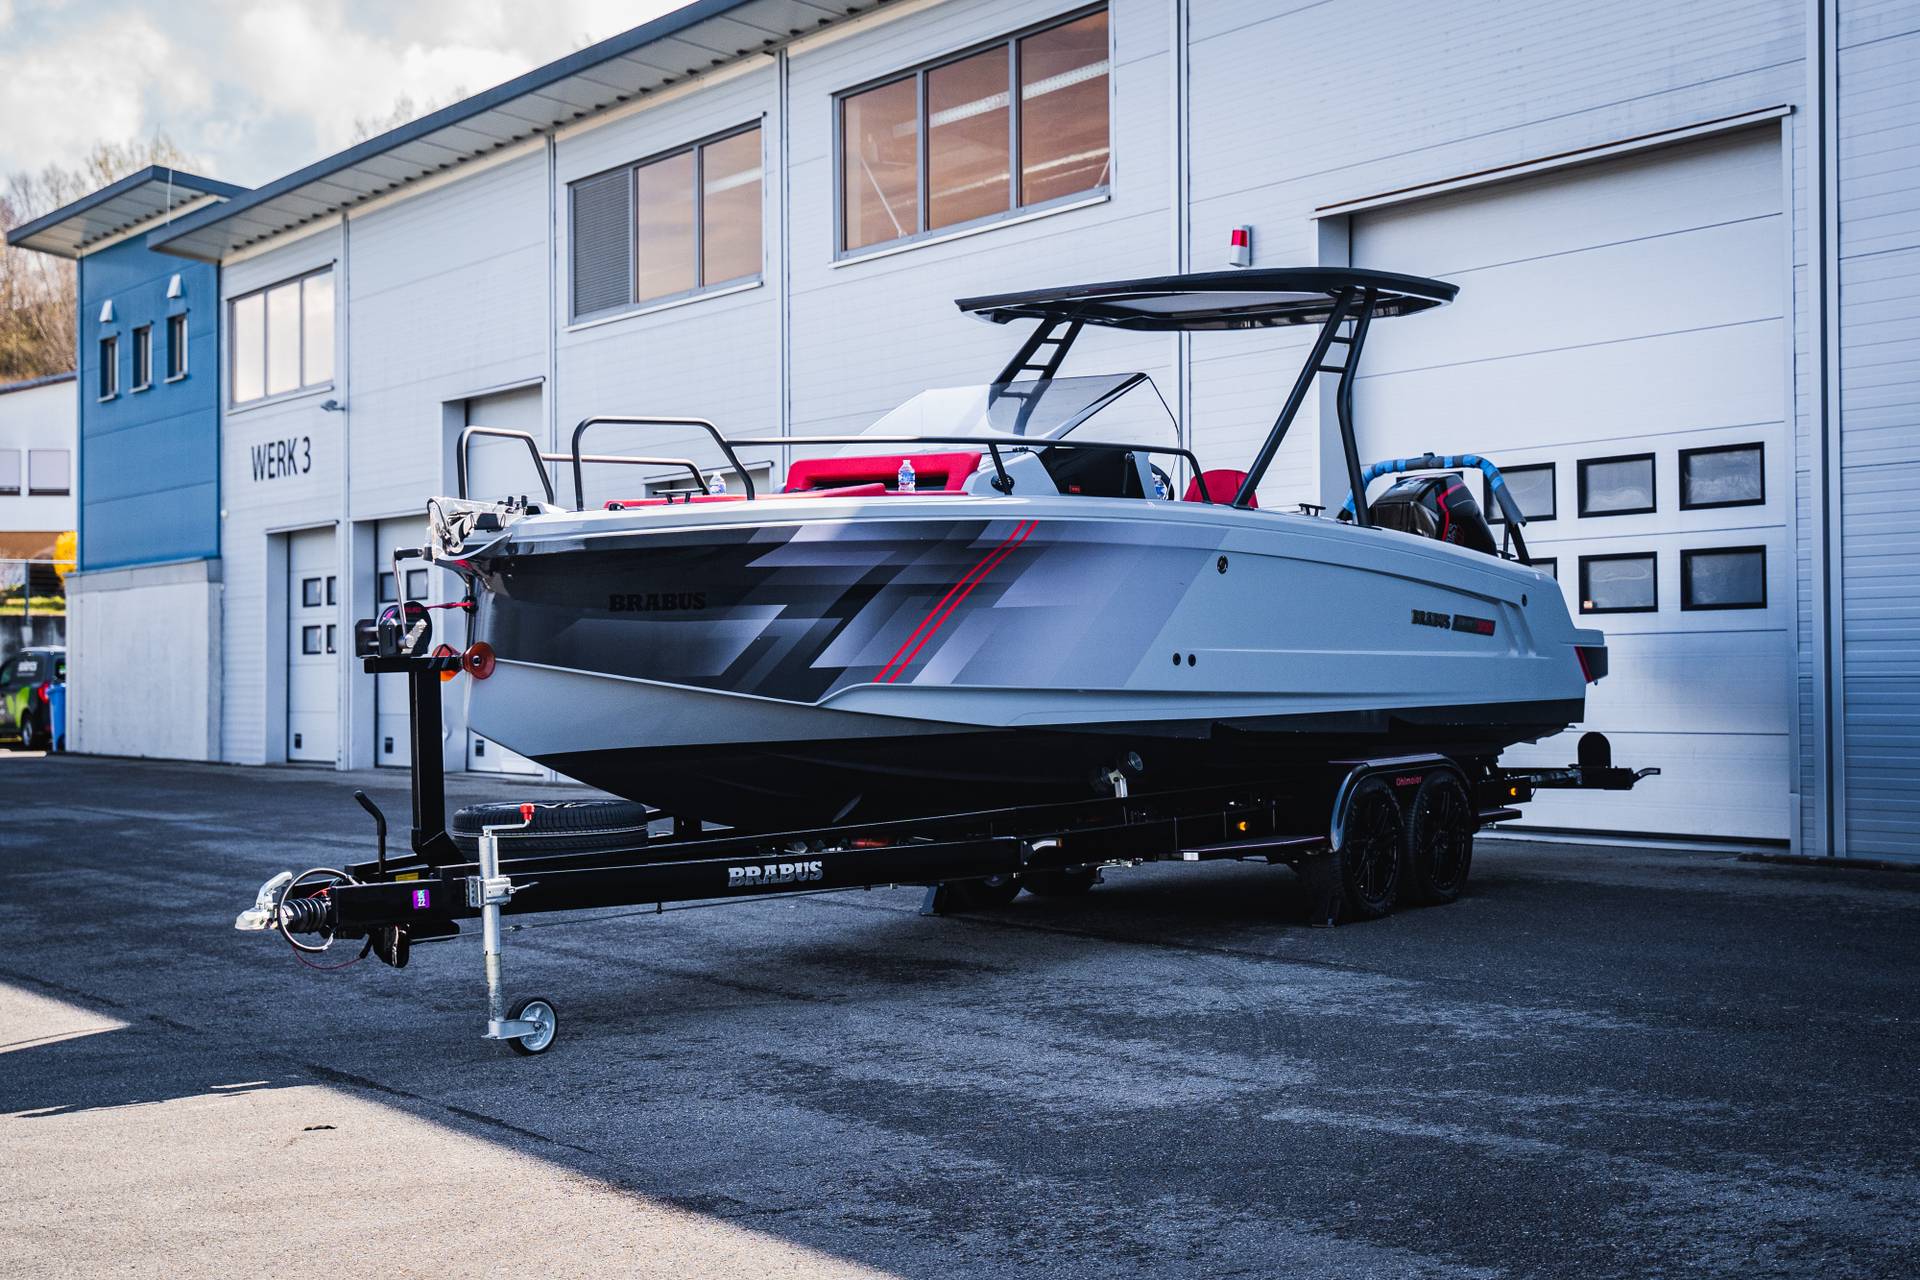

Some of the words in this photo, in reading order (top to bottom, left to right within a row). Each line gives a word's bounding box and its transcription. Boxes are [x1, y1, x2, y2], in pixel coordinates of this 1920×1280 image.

[251, 438, 298, 482] WERK
[302, 436, 312, 474] 3
[608, 592, 706, 612] BRABUS
[727, 861, 824, 888] BRABUS
